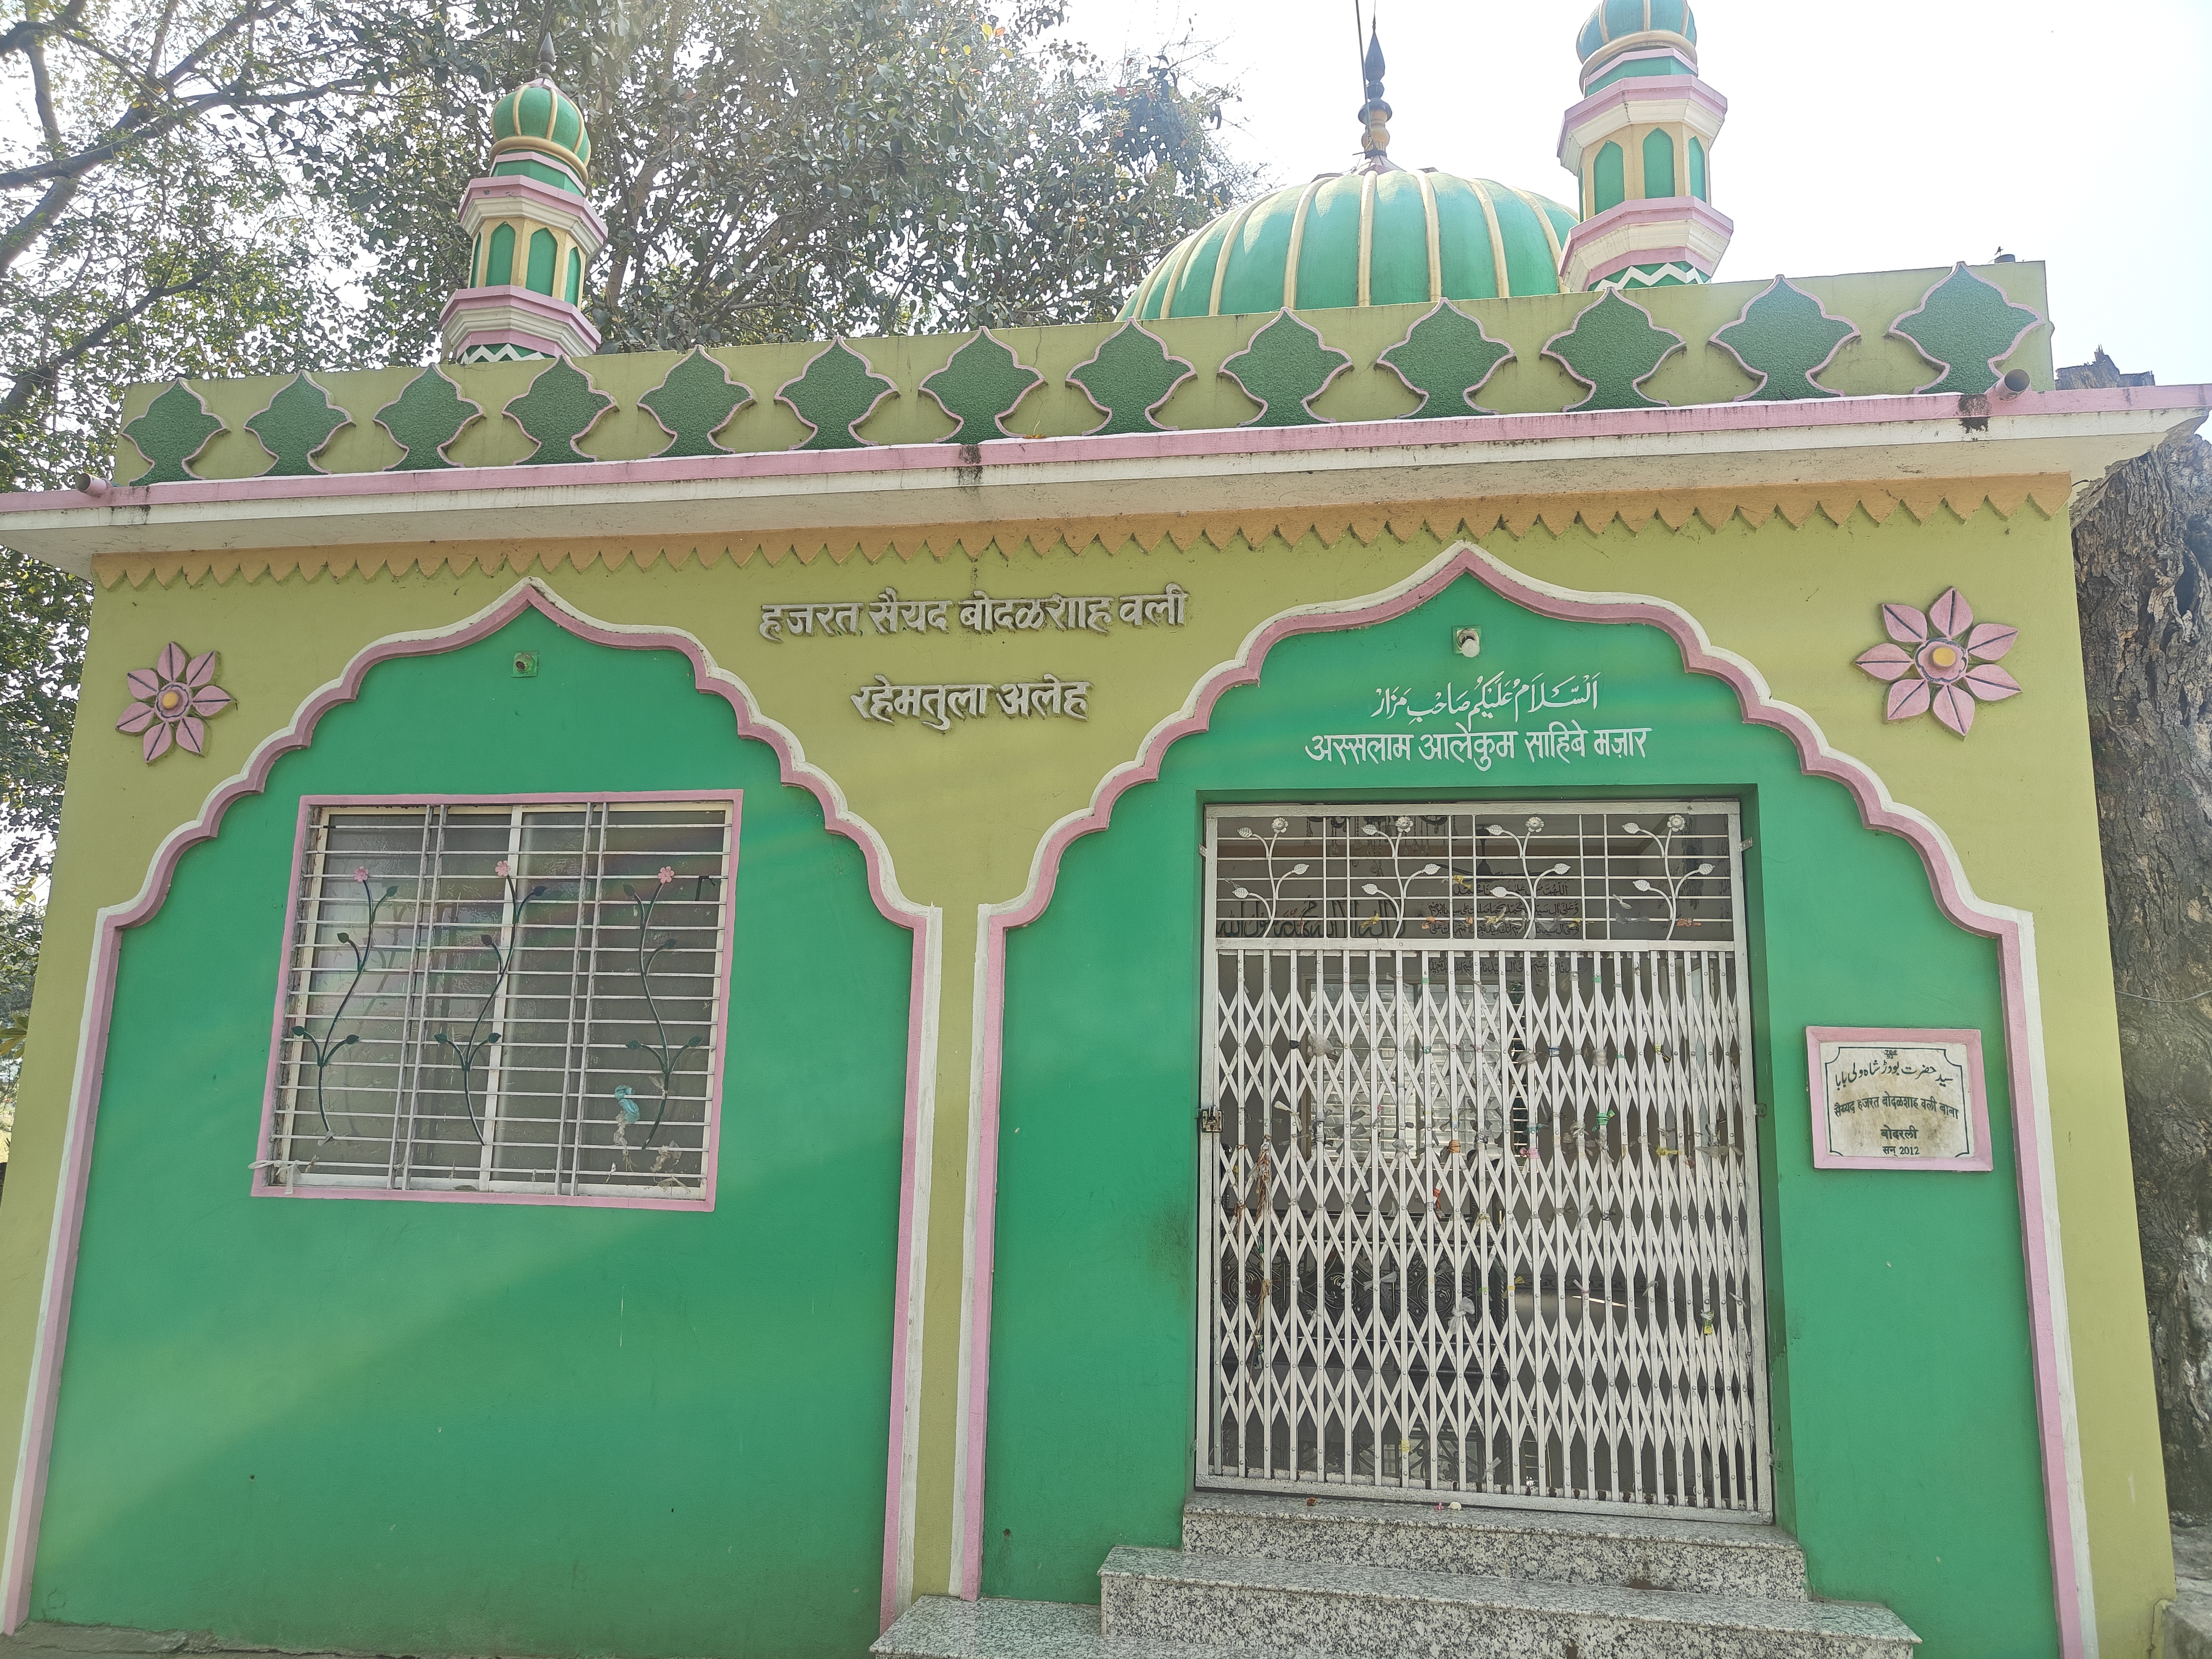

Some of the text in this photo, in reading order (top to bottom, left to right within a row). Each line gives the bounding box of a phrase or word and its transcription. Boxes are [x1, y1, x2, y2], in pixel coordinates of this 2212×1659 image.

[759, 602, 864, 643] हजरत
[869, 586, 953, 634] सैयद
[1119, 582, 1189, 626] वली
[851, 673, 1092, 734] रहेमतुला अलेह
[1305, 719, 1654, 772] अस्सलाम आलेकुम साहिबे मज़ार
[1901, 1064, 1937, 1080] حضرت
[1857, 1096, 1880, 1111] हजरत
[1920, 1095, 1938, 1112] वली
[1939, 1102, 1959, 1120] बाबा
[1880, 1124, 1919, 1140] बोदरली
[1899, 1146, 1920, 1155] 2012
